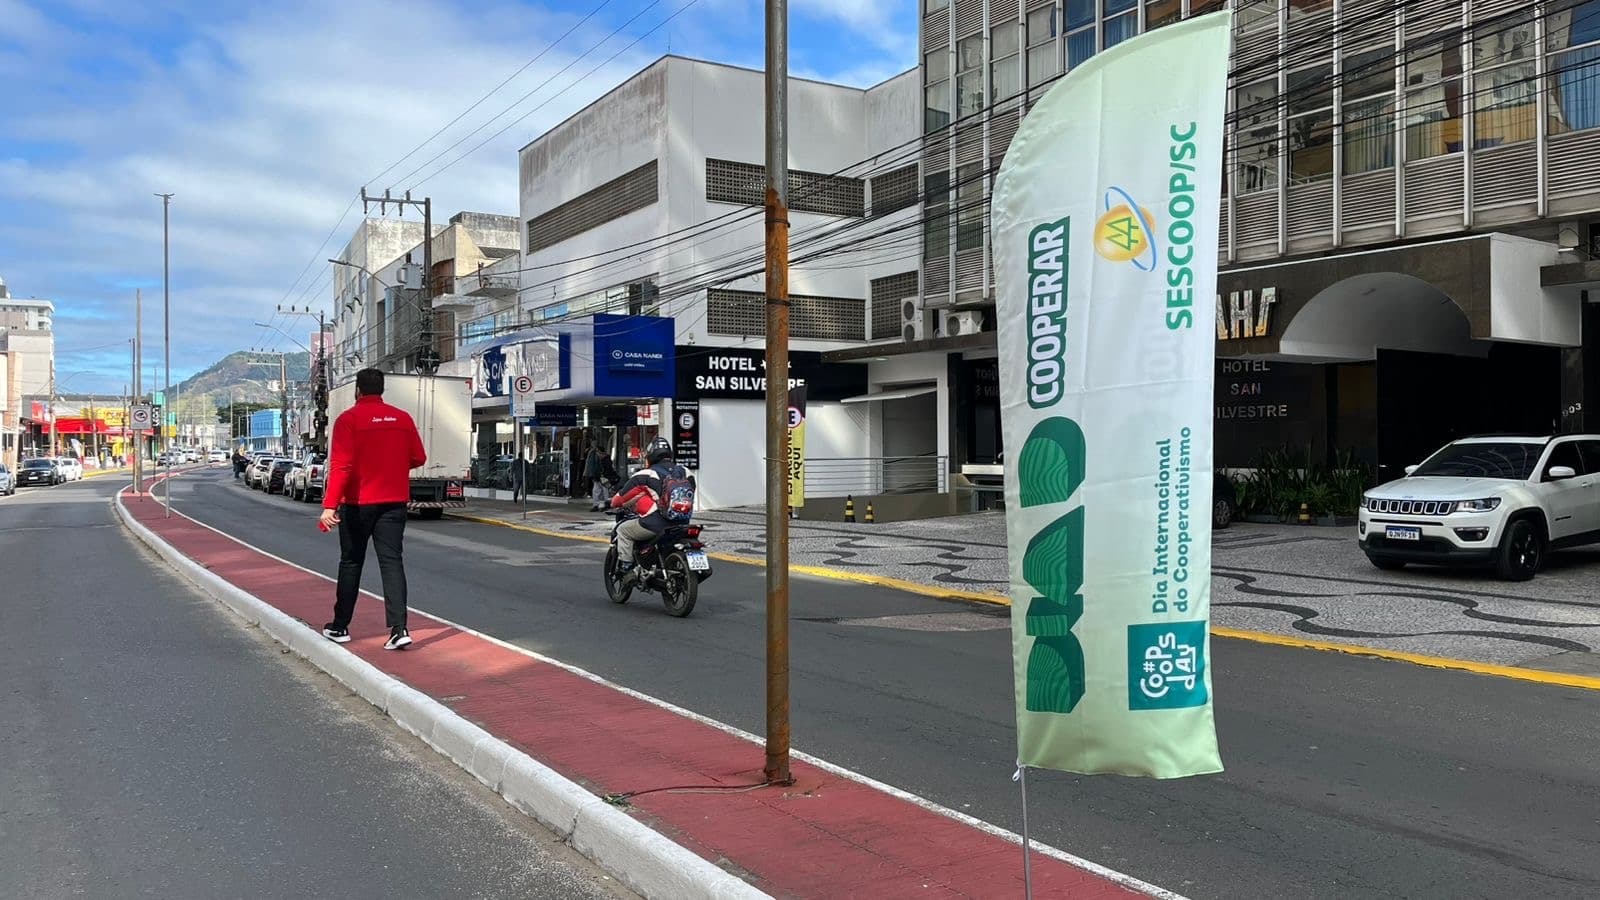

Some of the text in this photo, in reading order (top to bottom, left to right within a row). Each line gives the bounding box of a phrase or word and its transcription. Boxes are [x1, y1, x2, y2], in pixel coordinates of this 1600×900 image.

[1166, 121, 1197, 330] SESCOOP/SC
[1027, 217, 1069, 409] COOPERAR
[708, 356, 756, 371] HOTEL
[1222, 360, 1270, 373] HOTEL
[520, 380, 527, 390] E
[695, 375, 805, 392] SAN SILVERE
[1230, 383, 1261, 395] SAN
[1216, 404, 1288, 419] ILVESTRE
[683, 416, 690, 426] E
[793, 447, 802, 480] AQUI
[1153, 438, 1171, 613] Dia Internacional
[1173, 426, 1192, 613] do Cooperativismo
